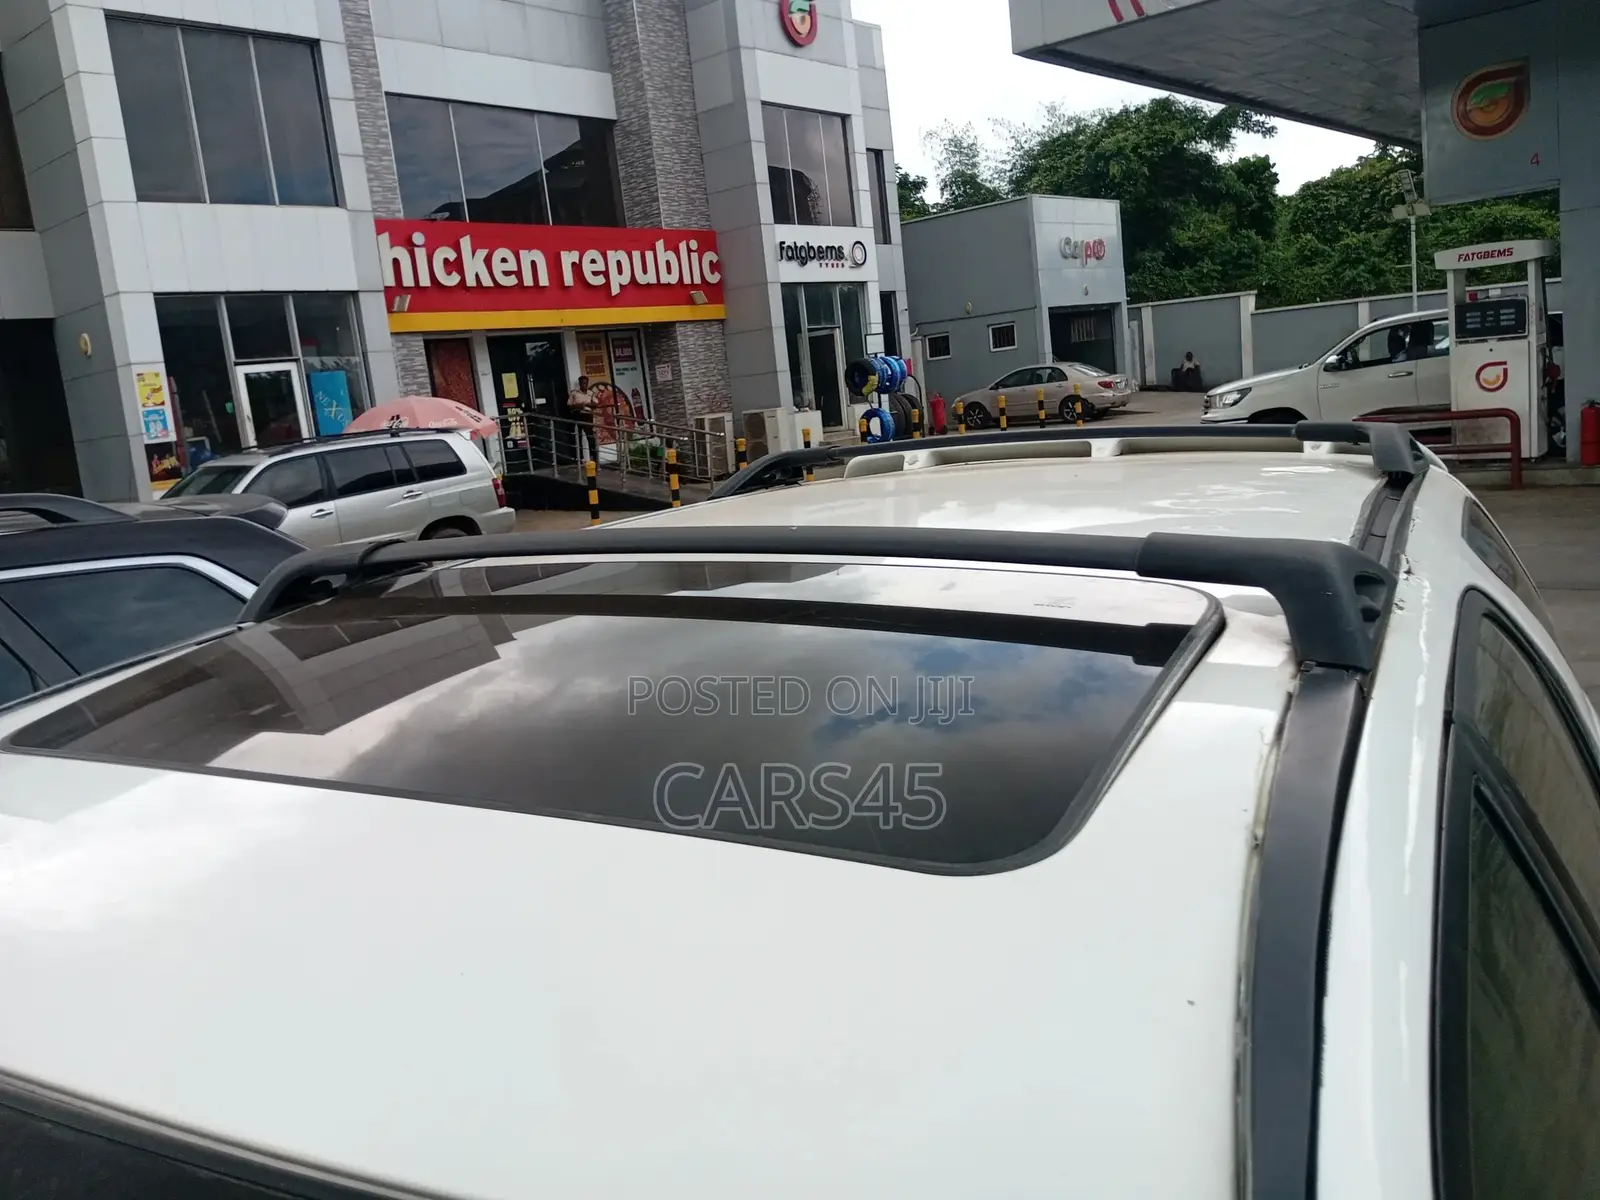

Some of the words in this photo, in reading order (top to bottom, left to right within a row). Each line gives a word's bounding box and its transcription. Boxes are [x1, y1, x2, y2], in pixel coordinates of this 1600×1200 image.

[1530, 151, 1541, 167] 4
[1457, 246, 1515, 263] FATGBEMS
[377, 231, 549, 288] hicken
[560, 238, 722, 297] republic
